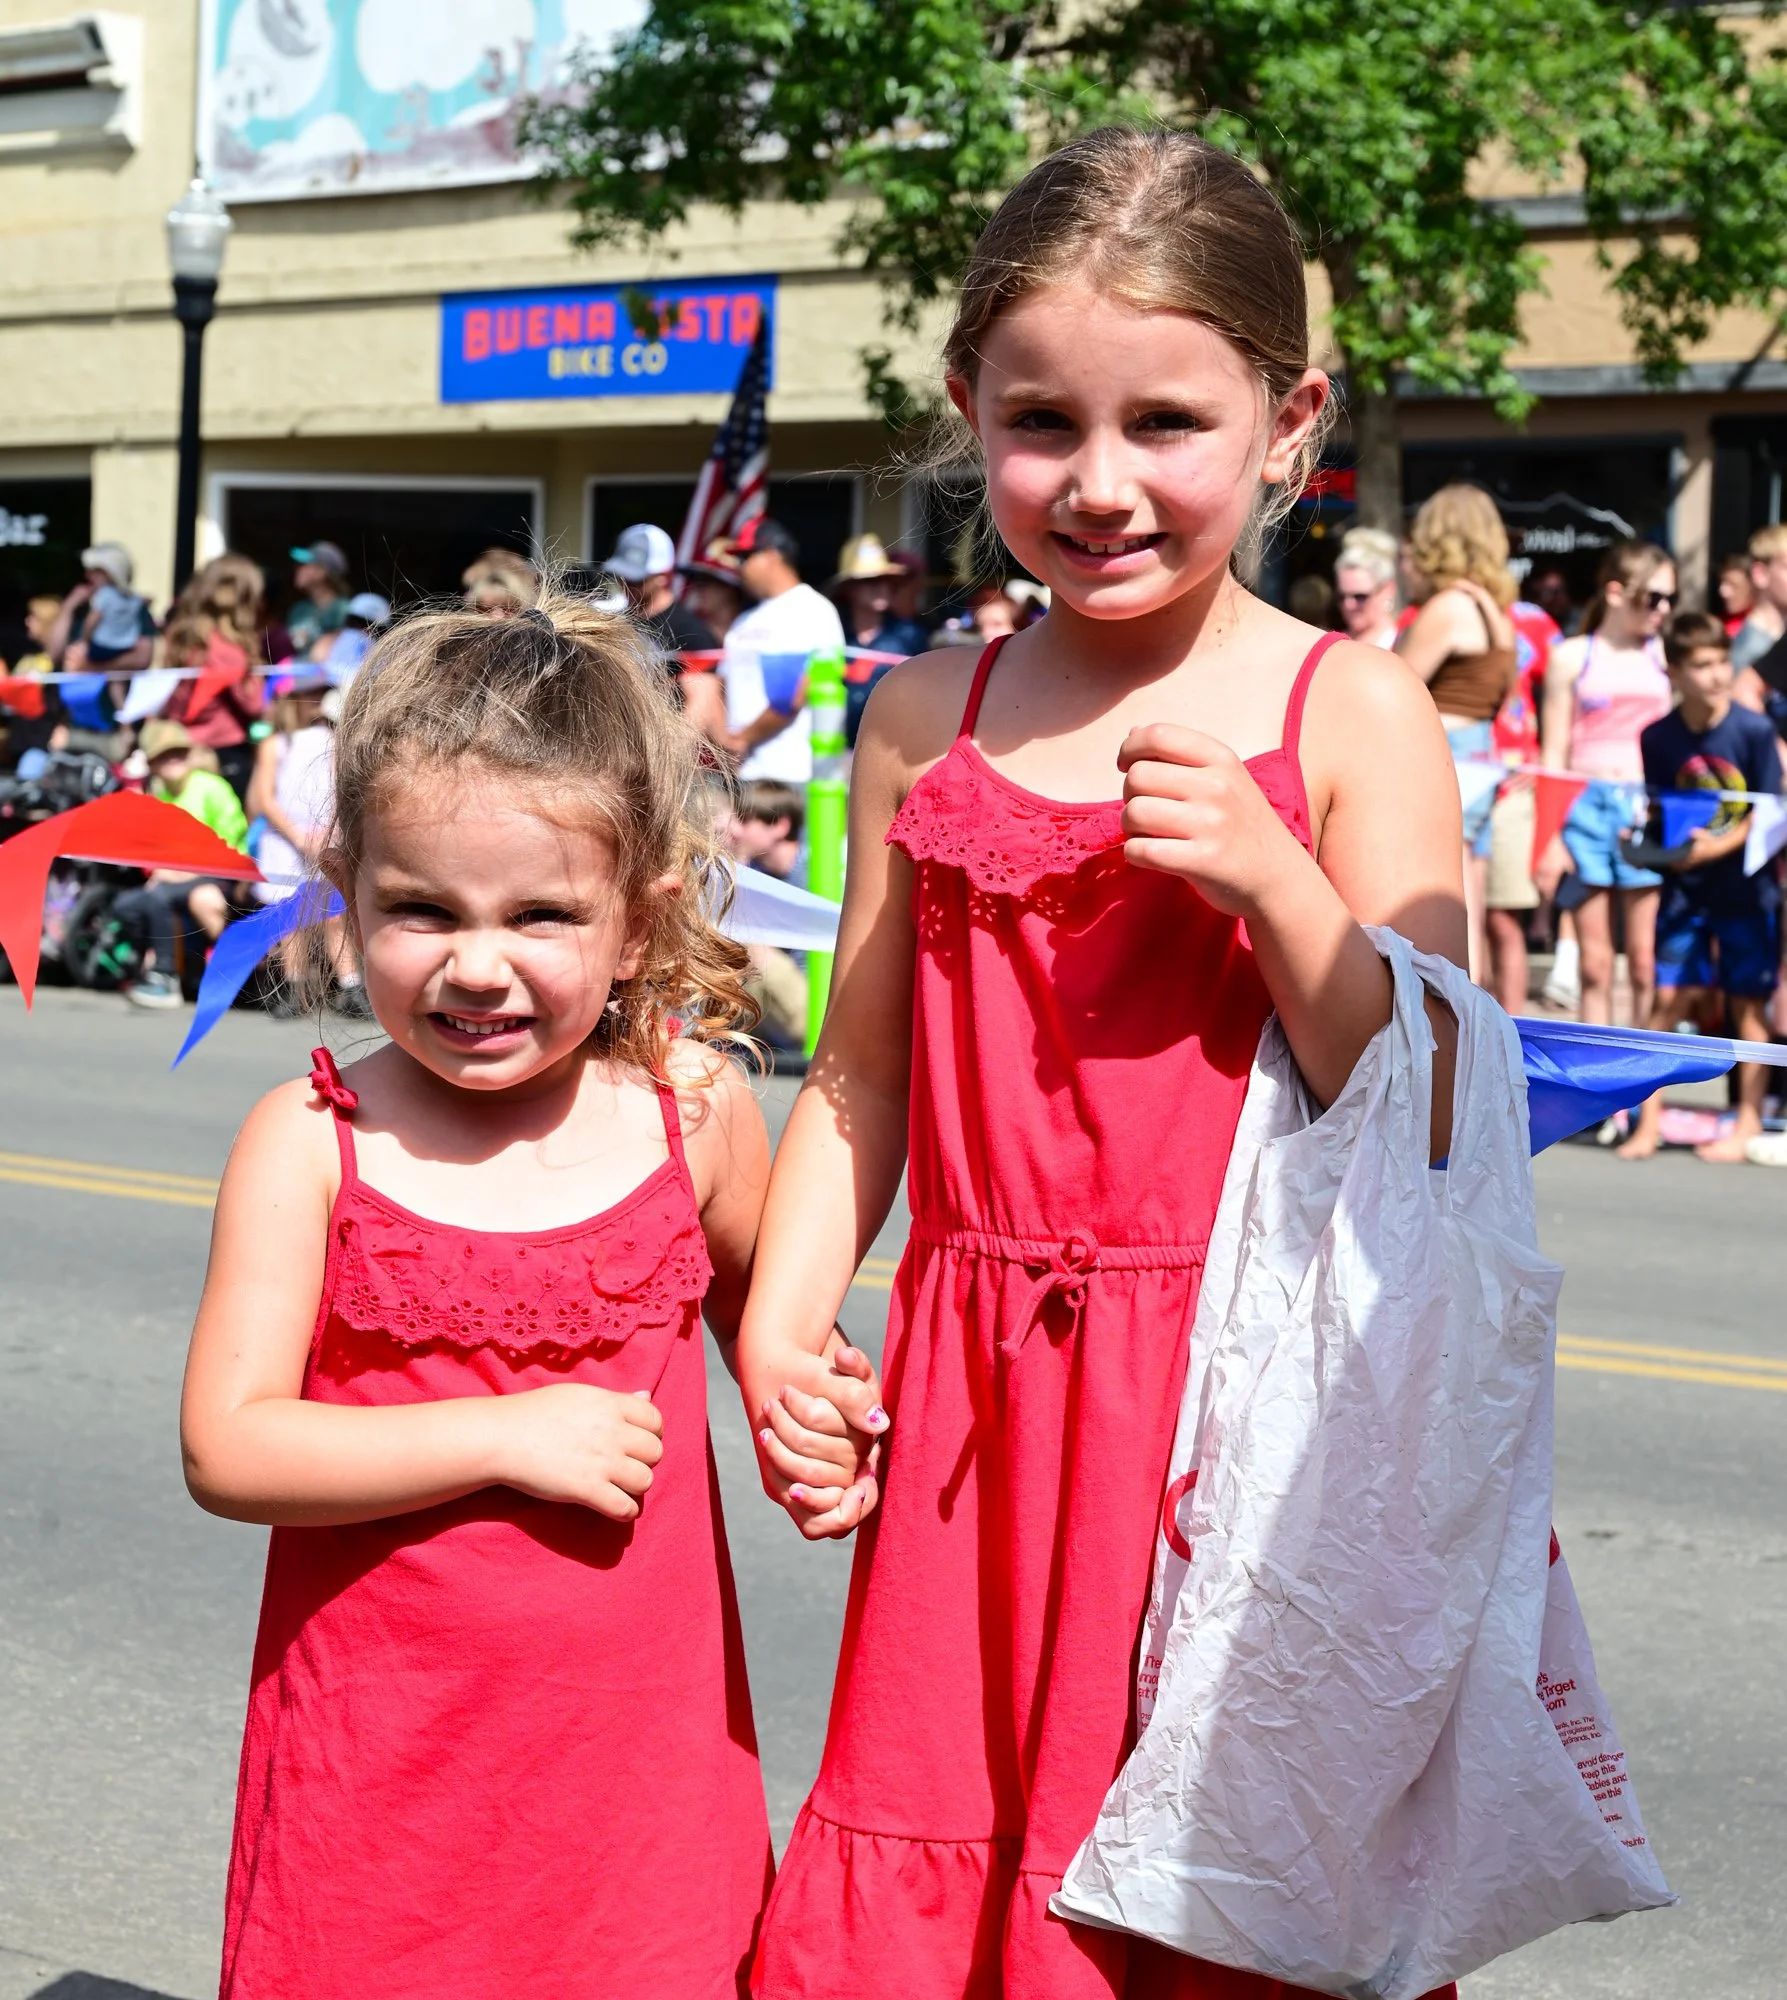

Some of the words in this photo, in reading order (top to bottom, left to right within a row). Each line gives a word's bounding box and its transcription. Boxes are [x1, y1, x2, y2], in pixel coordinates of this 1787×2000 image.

[463, 302, 616, 363] BUENA
[633, 292, 760, 347] ISTA
[549, 345, 615, 379] BIKE
[621, 341, 669, 377] CO
[1145, 1655, 1162, 1669] The
[1599, 1752, 1624, 1762] danger
[1581, 1769, 1599, 1779] keep
[1601, 1763, 1617, 1775] this
[1612, 1772, 1628, 1783] and
[1607, 1787, 1622, 1799] this
